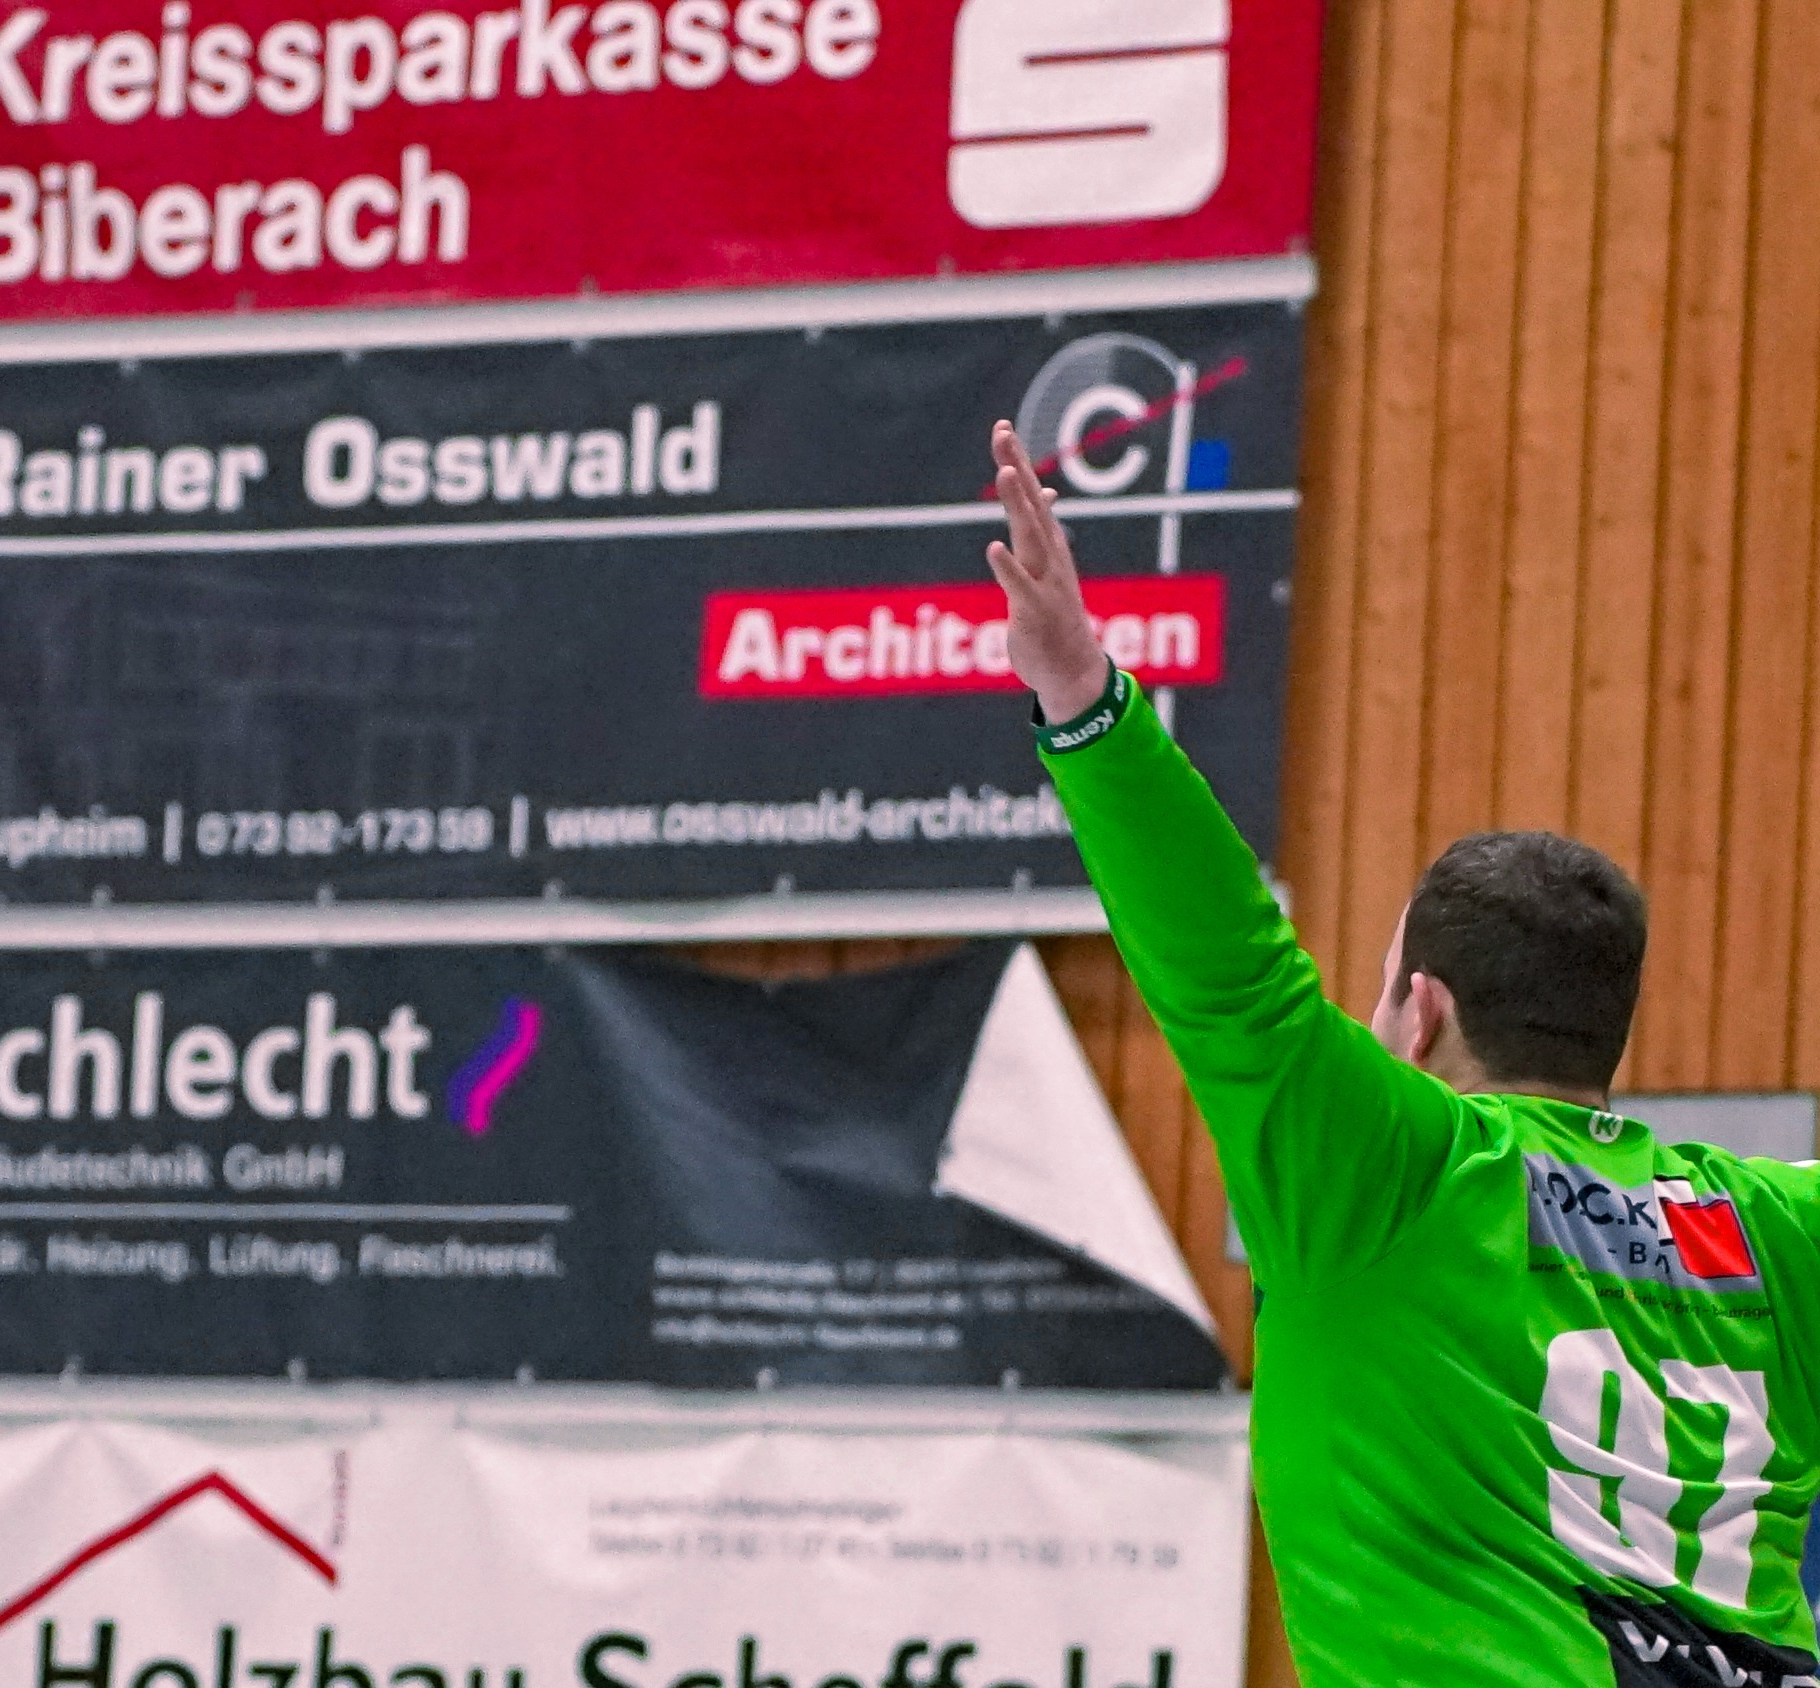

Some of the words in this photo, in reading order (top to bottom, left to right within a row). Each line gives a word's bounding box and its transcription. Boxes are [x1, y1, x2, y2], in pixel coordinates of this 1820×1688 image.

[303, 401, 722, 508] Osswald
[717, 602, 1201, 683] Architeen
[221, 1142, 346, 1191] GmbH
[1539, 1327, 1774, 1609] 97
